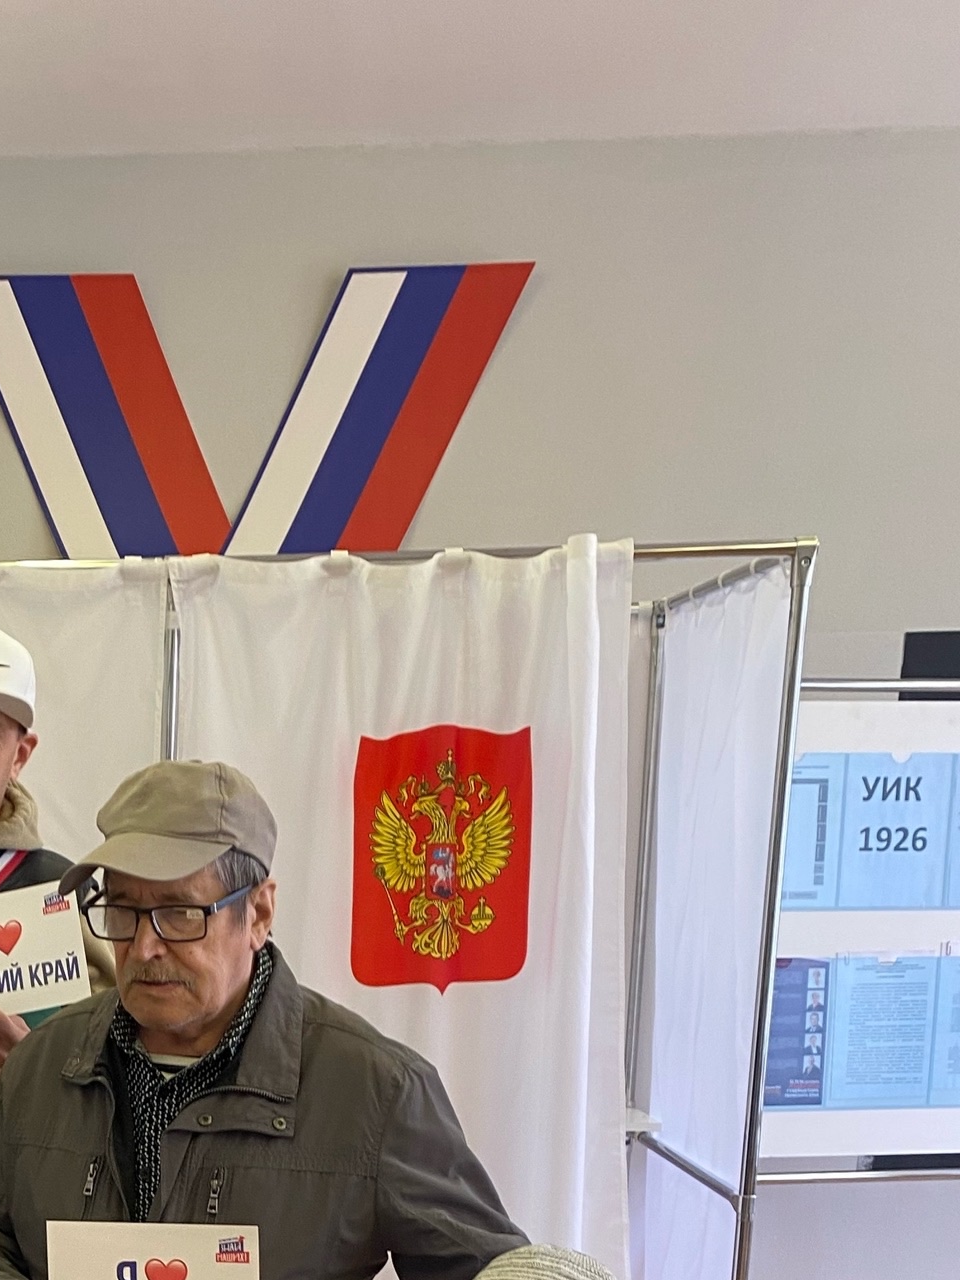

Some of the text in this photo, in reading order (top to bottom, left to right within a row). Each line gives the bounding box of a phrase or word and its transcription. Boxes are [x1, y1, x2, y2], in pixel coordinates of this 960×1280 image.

[861, 776, 923, 802] УИК
[858, 826, 928, 852] 1926
[28, 951, 81, 988] КРАЙ
